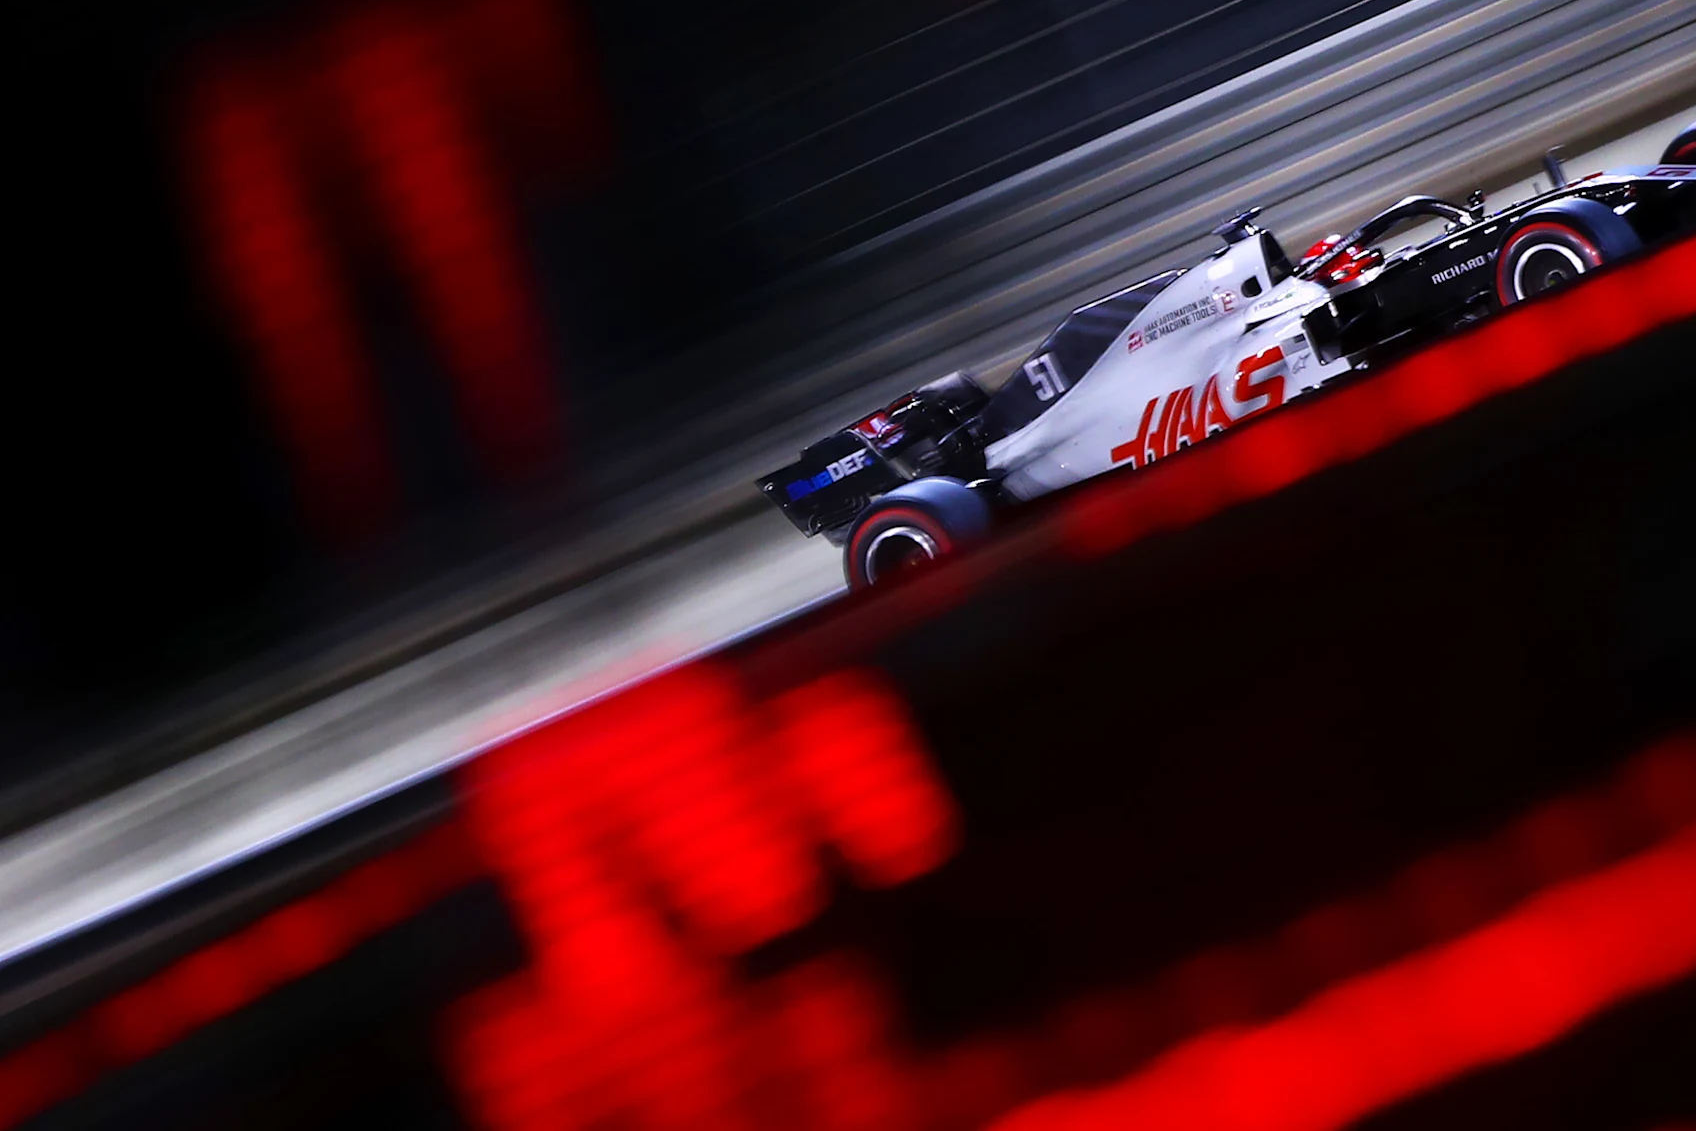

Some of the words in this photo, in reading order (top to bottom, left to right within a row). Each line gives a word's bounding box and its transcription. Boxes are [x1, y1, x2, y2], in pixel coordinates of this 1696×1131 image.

[1431, 255, 1486, 285] RICHARD
[1159, 300, 1199, 325] AUTOMATION
[1159, 318, 1191, 339] MACHINE
[1191, 305, 1217, 323] TOOLS
[1022, 352, 1066, 402] 51
[1111, 345, 1286, 470] HAAS
